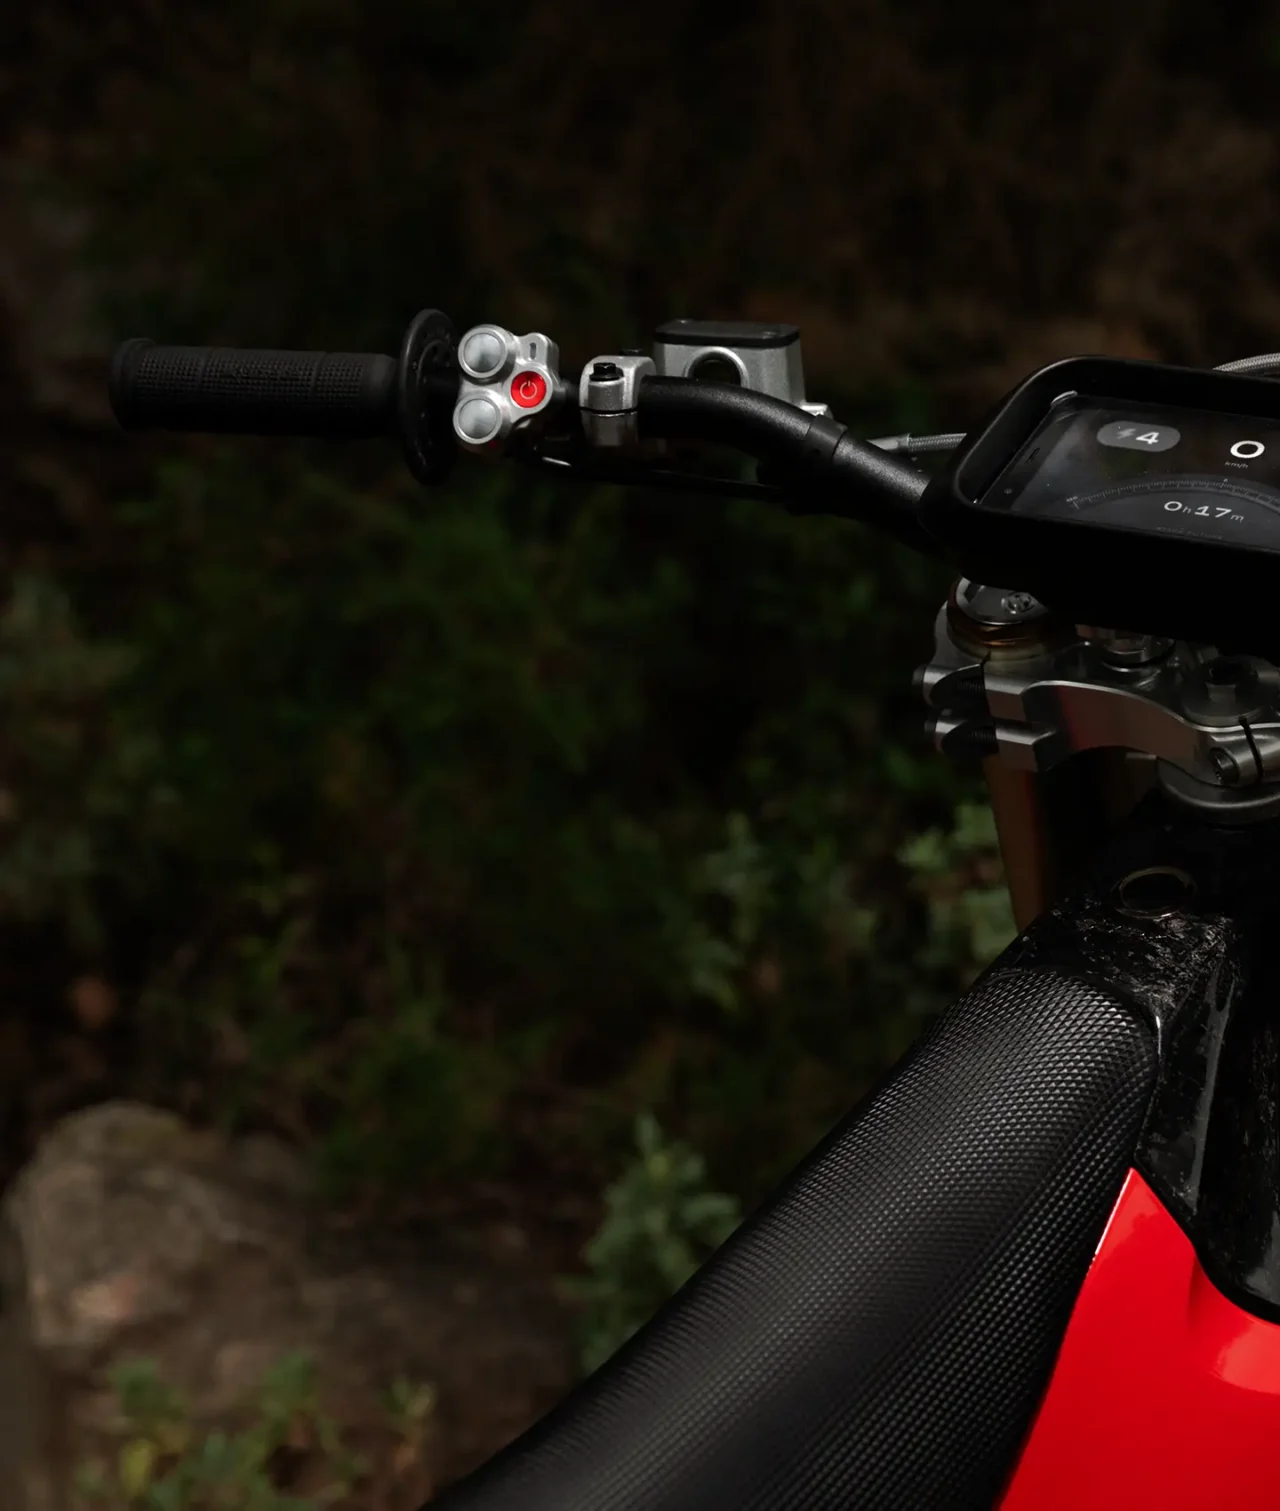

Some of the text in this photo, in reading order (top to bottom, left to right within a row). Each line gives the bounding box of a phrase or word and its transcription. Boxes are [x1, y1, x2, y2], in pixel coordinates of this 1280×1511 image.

[1135, 431, 1160, 445] 4
[1230, 440, 1265, 459] 0
[1224, 460, 1249, 469] km/h
